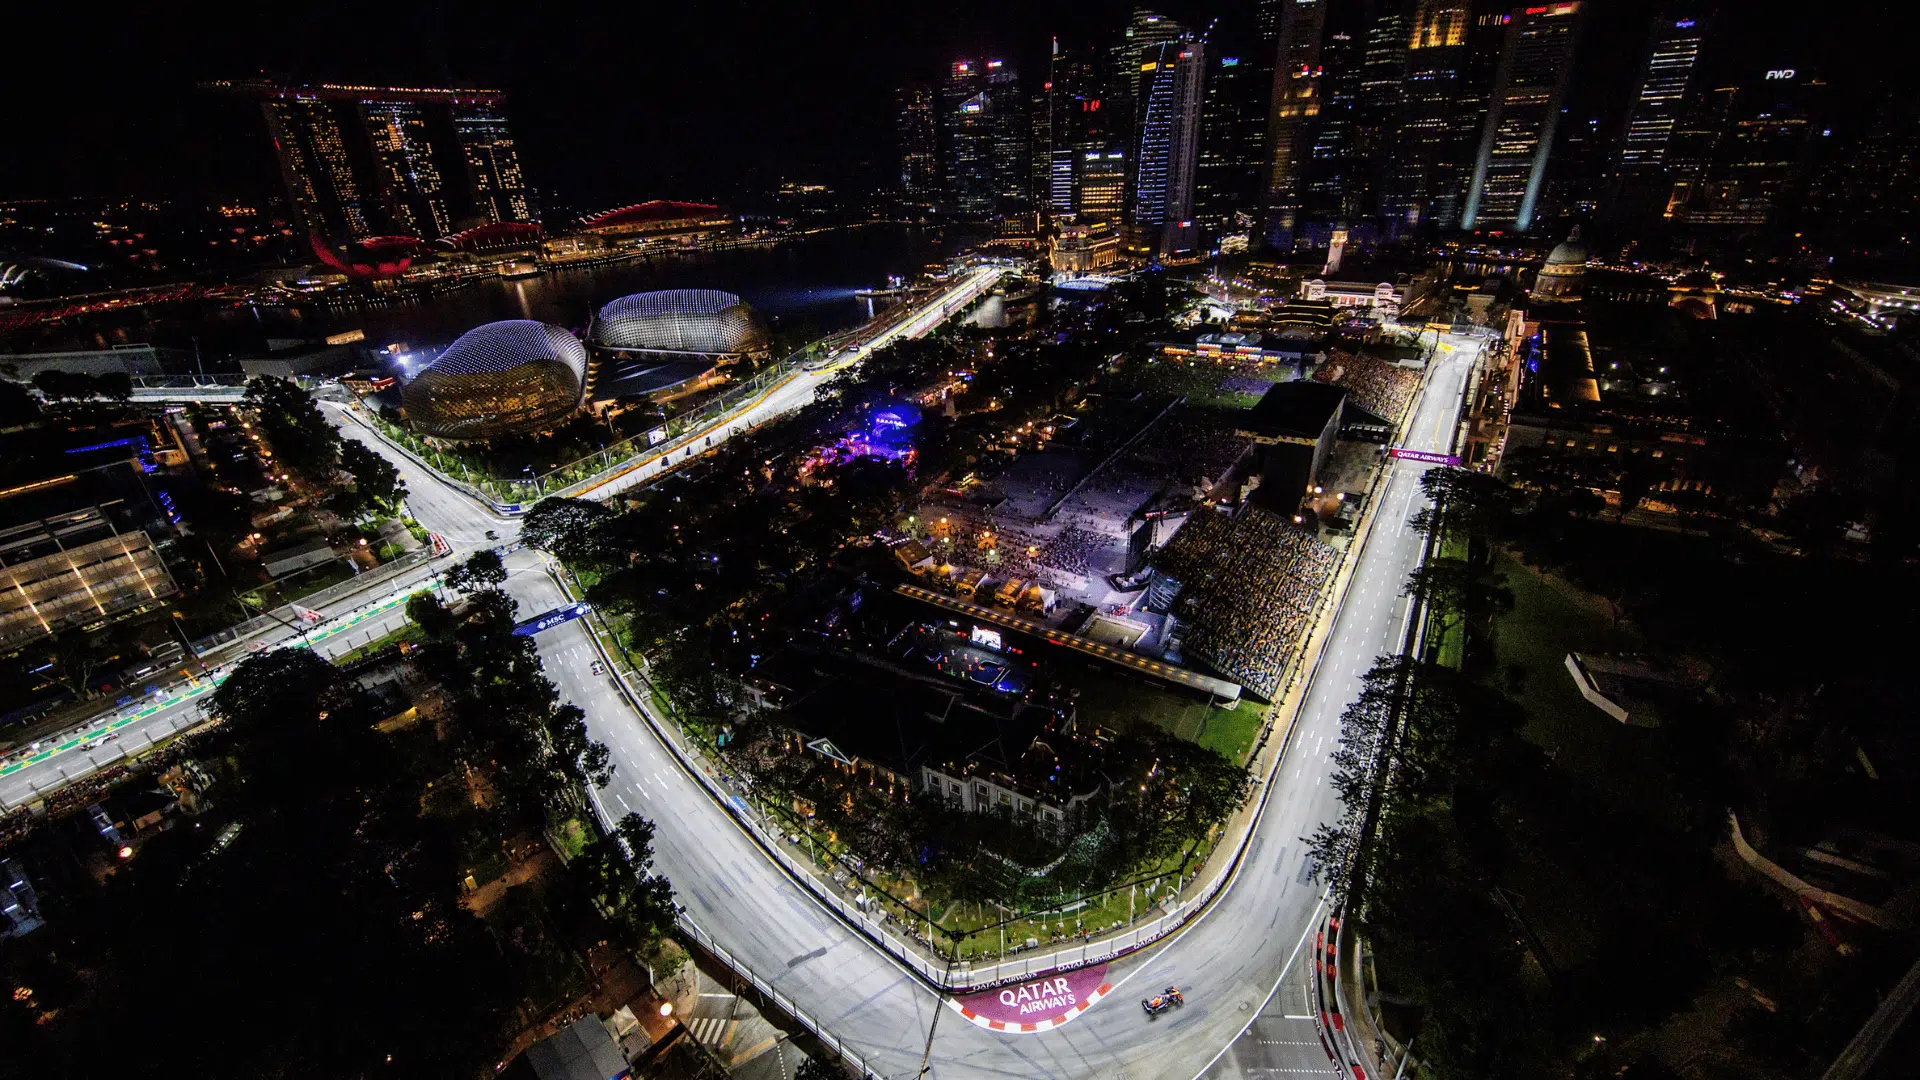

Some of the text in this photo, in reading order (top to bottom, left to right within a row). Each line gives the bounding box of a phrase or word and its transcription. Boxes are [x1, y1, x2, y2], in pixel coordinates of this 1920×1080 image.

[1765, 69, 1795, 80] FWD
[1397, 451, 1448, 463] QATAR AIRWAYS
[546, 614, 565, 626] MSC
[1057, 951, 1119, 972] QATAR AIRWAYS
[972, 972, 1037, 991] QATAR AIRWAYS
[999, 977, 1072, 1007] QATAR
[1020, 994, 1076, 1015] AIRWAYS
